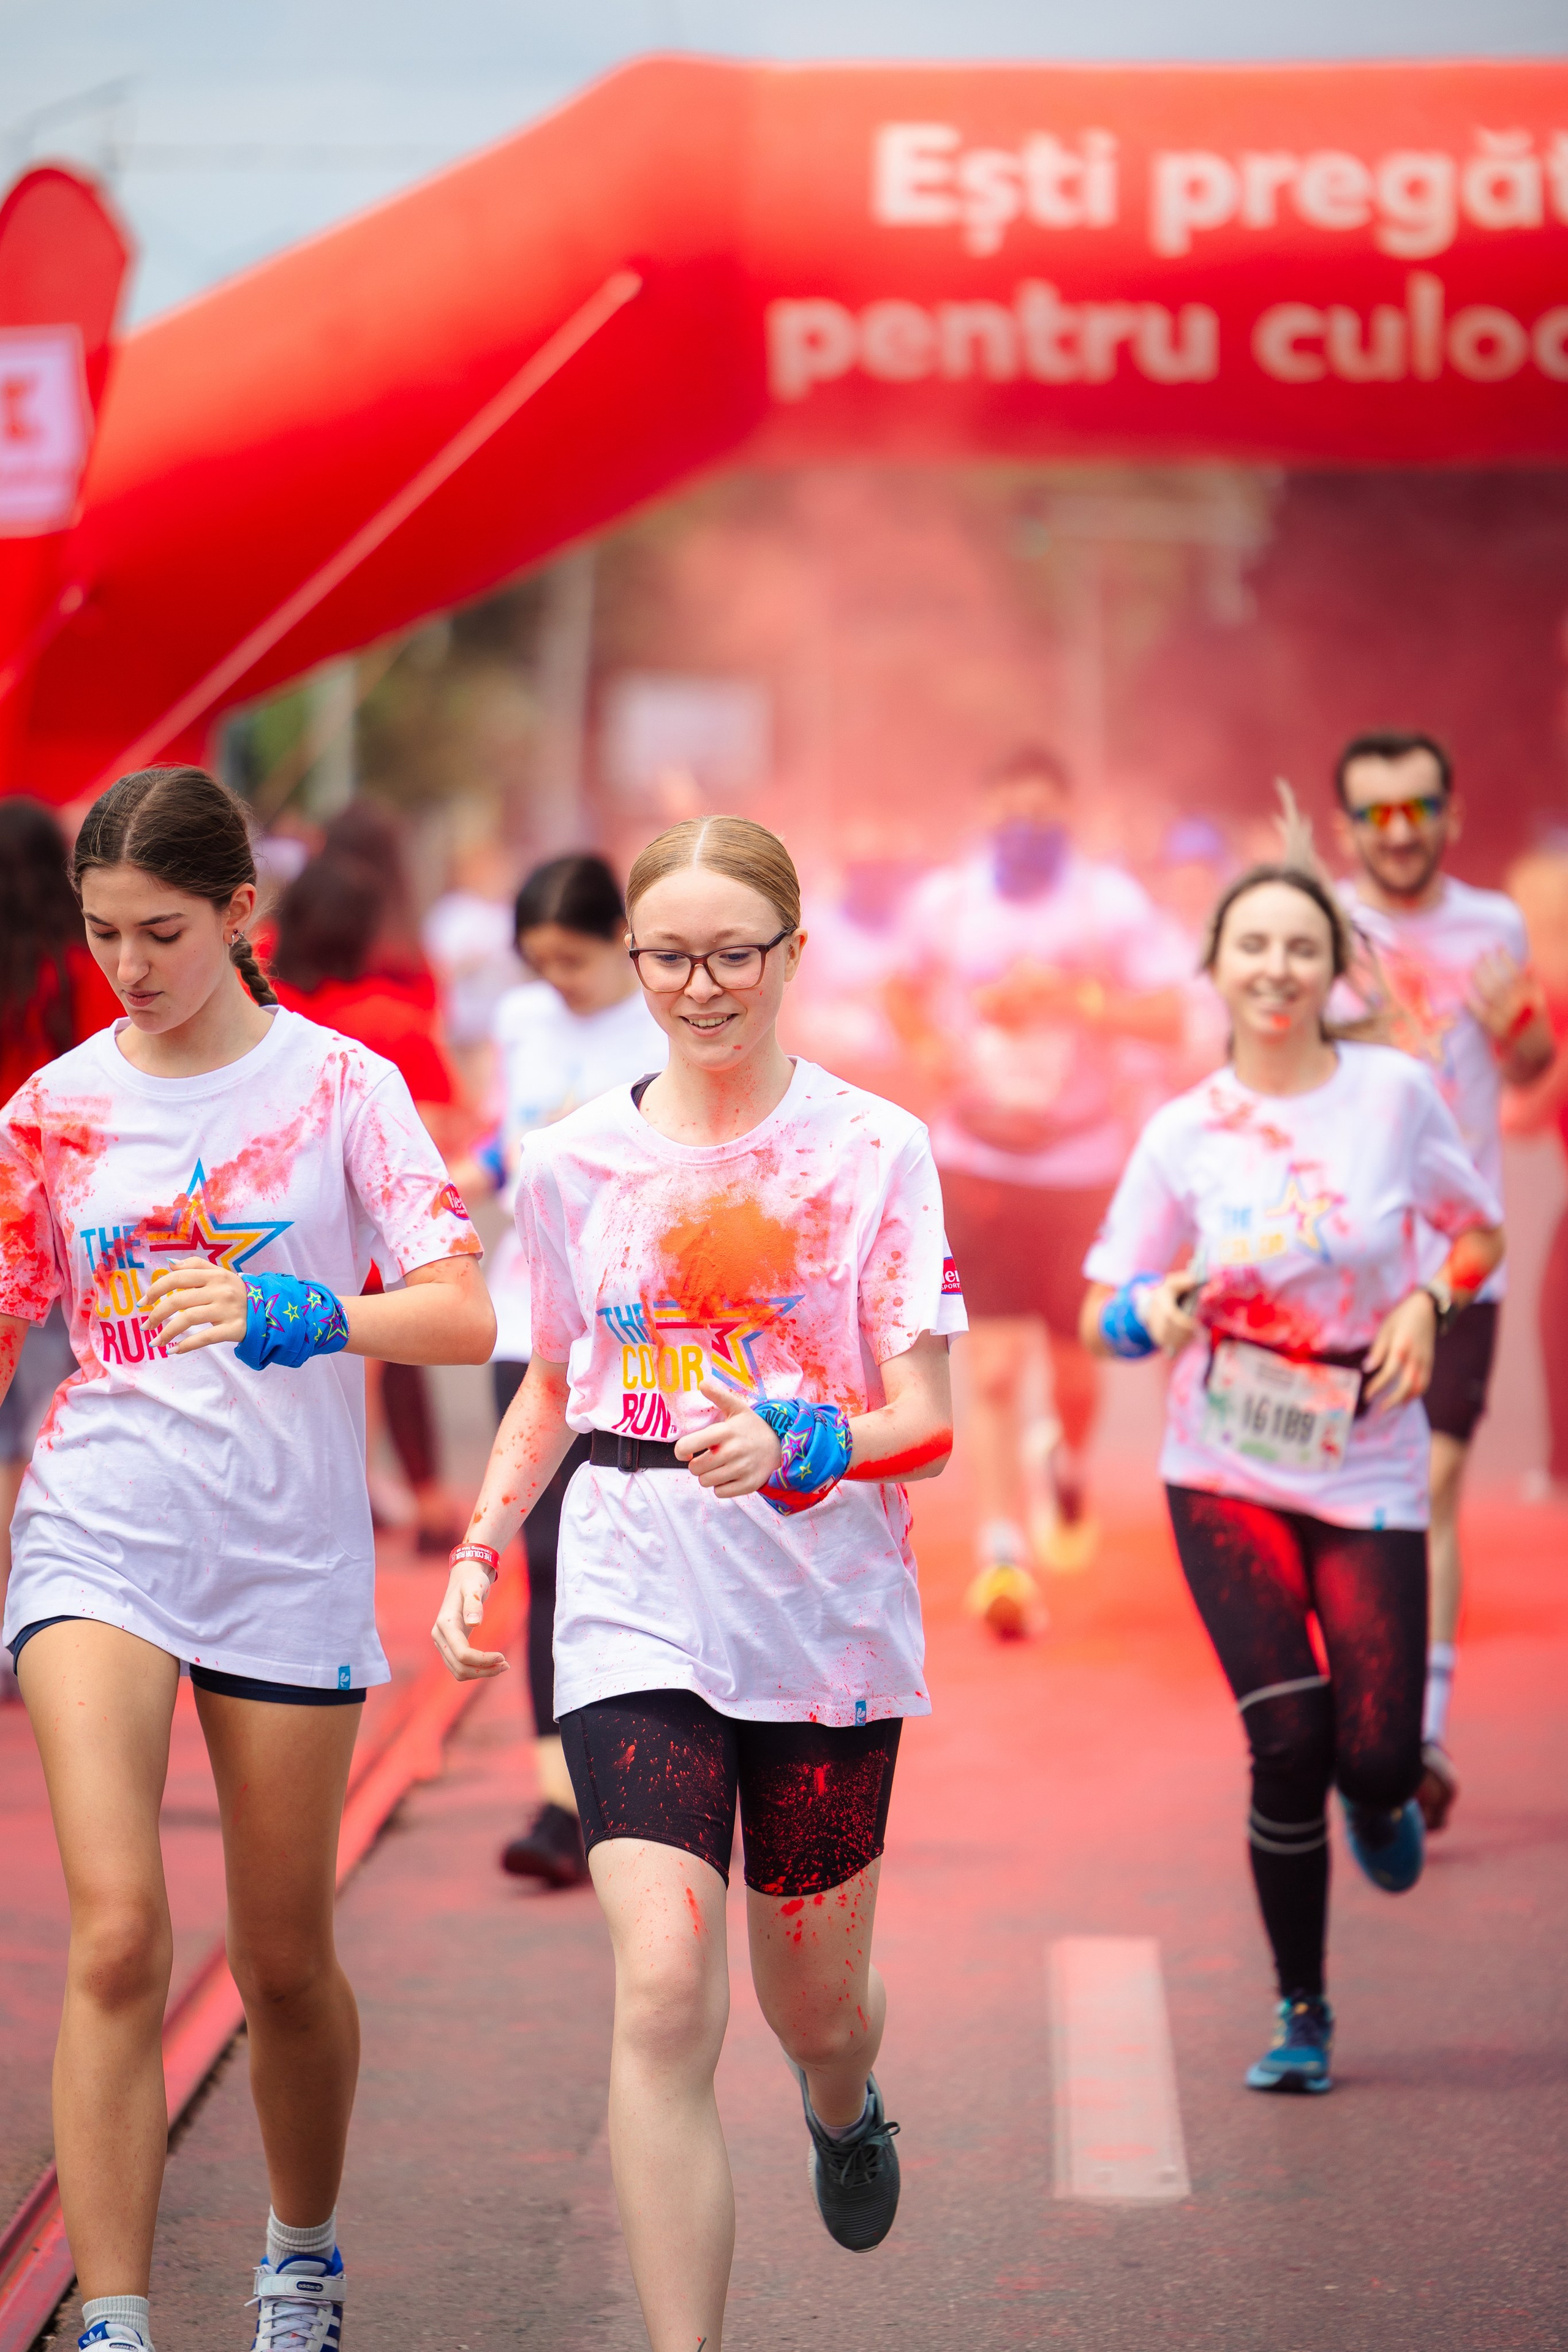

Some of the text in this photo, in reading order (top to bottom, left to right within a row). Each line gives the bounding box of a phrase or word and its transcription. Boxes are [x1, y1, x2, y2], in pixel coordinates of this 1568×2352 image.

[872, 121, 1118, 257] Ești
[766, 277, 1223, 404] pentru
[80, 1225, 145, 1275] THE
[99, 1316, 168, 1365] RUN
[596, 1303, 657, 1344] THE
[622, 1344, 704, 1393] COOR
[611, 1393, 671, 1438] RUN
[483, 1552, 492, 1562] THE
